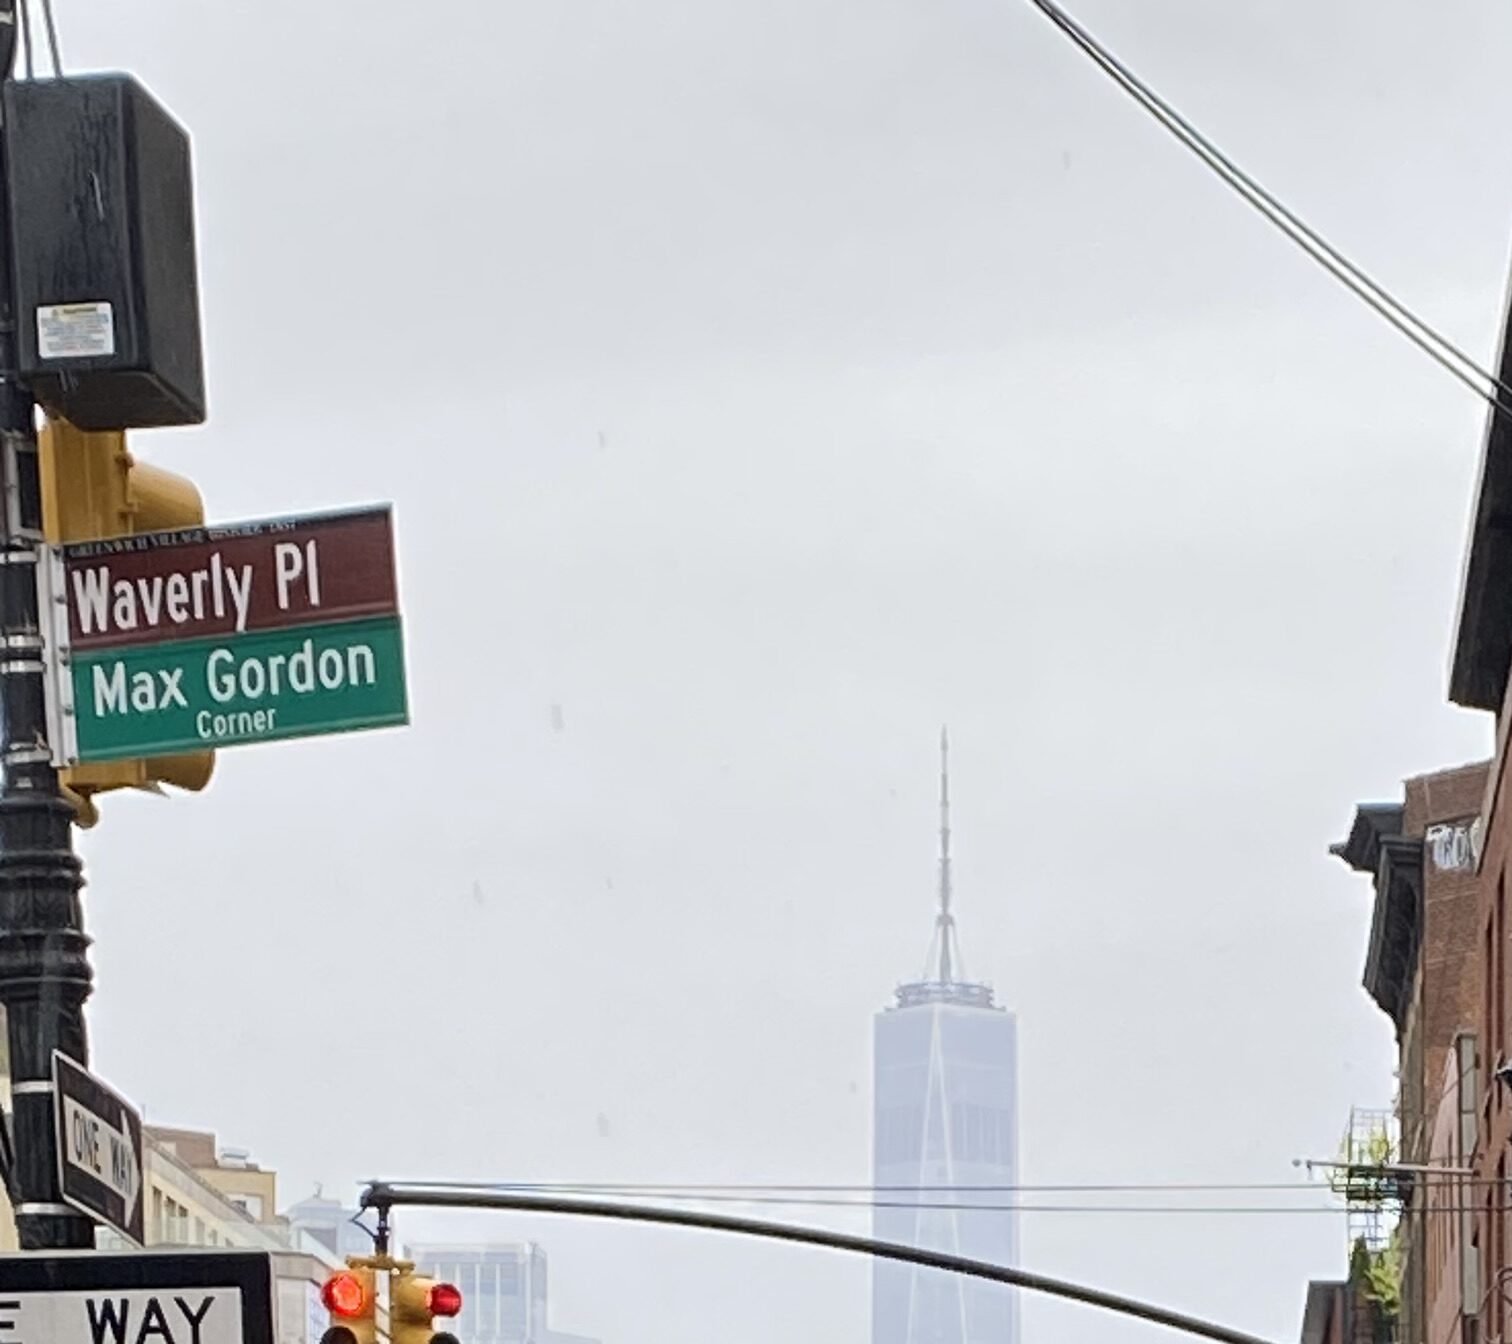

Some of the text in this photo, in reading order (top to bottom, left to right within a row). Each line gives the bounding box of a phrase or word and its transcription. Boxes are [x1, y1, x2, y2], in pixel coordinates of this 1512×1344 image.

[72, 539, 321, 634] Waverly Pl
[92, 638, 377, 718] Max Gordon
[196, 708, 277, 739] Corner
[73, 1109, 102, 1175] ONE
